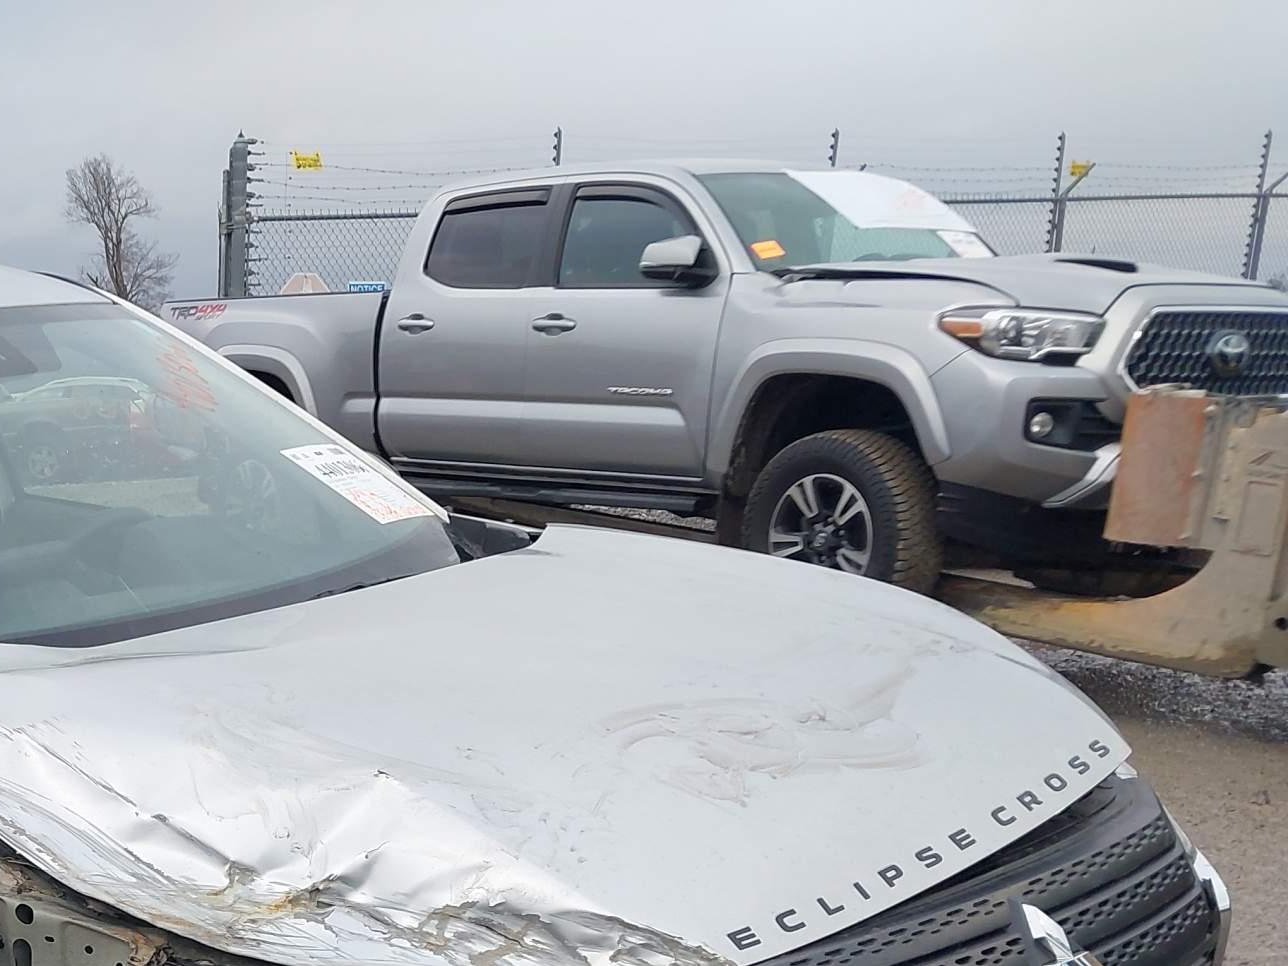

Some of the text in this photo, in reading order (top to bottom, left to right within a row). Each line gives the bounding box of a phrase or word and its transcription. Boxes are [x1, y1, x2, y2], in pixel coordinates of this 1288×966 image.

[350, 284, 383, 292] NOTICE
[171, 306, 199, 320] TRD
[314, 460, 370, 478] 44013
[727, 739, 1110, 950] ECLIPSE CROSS
